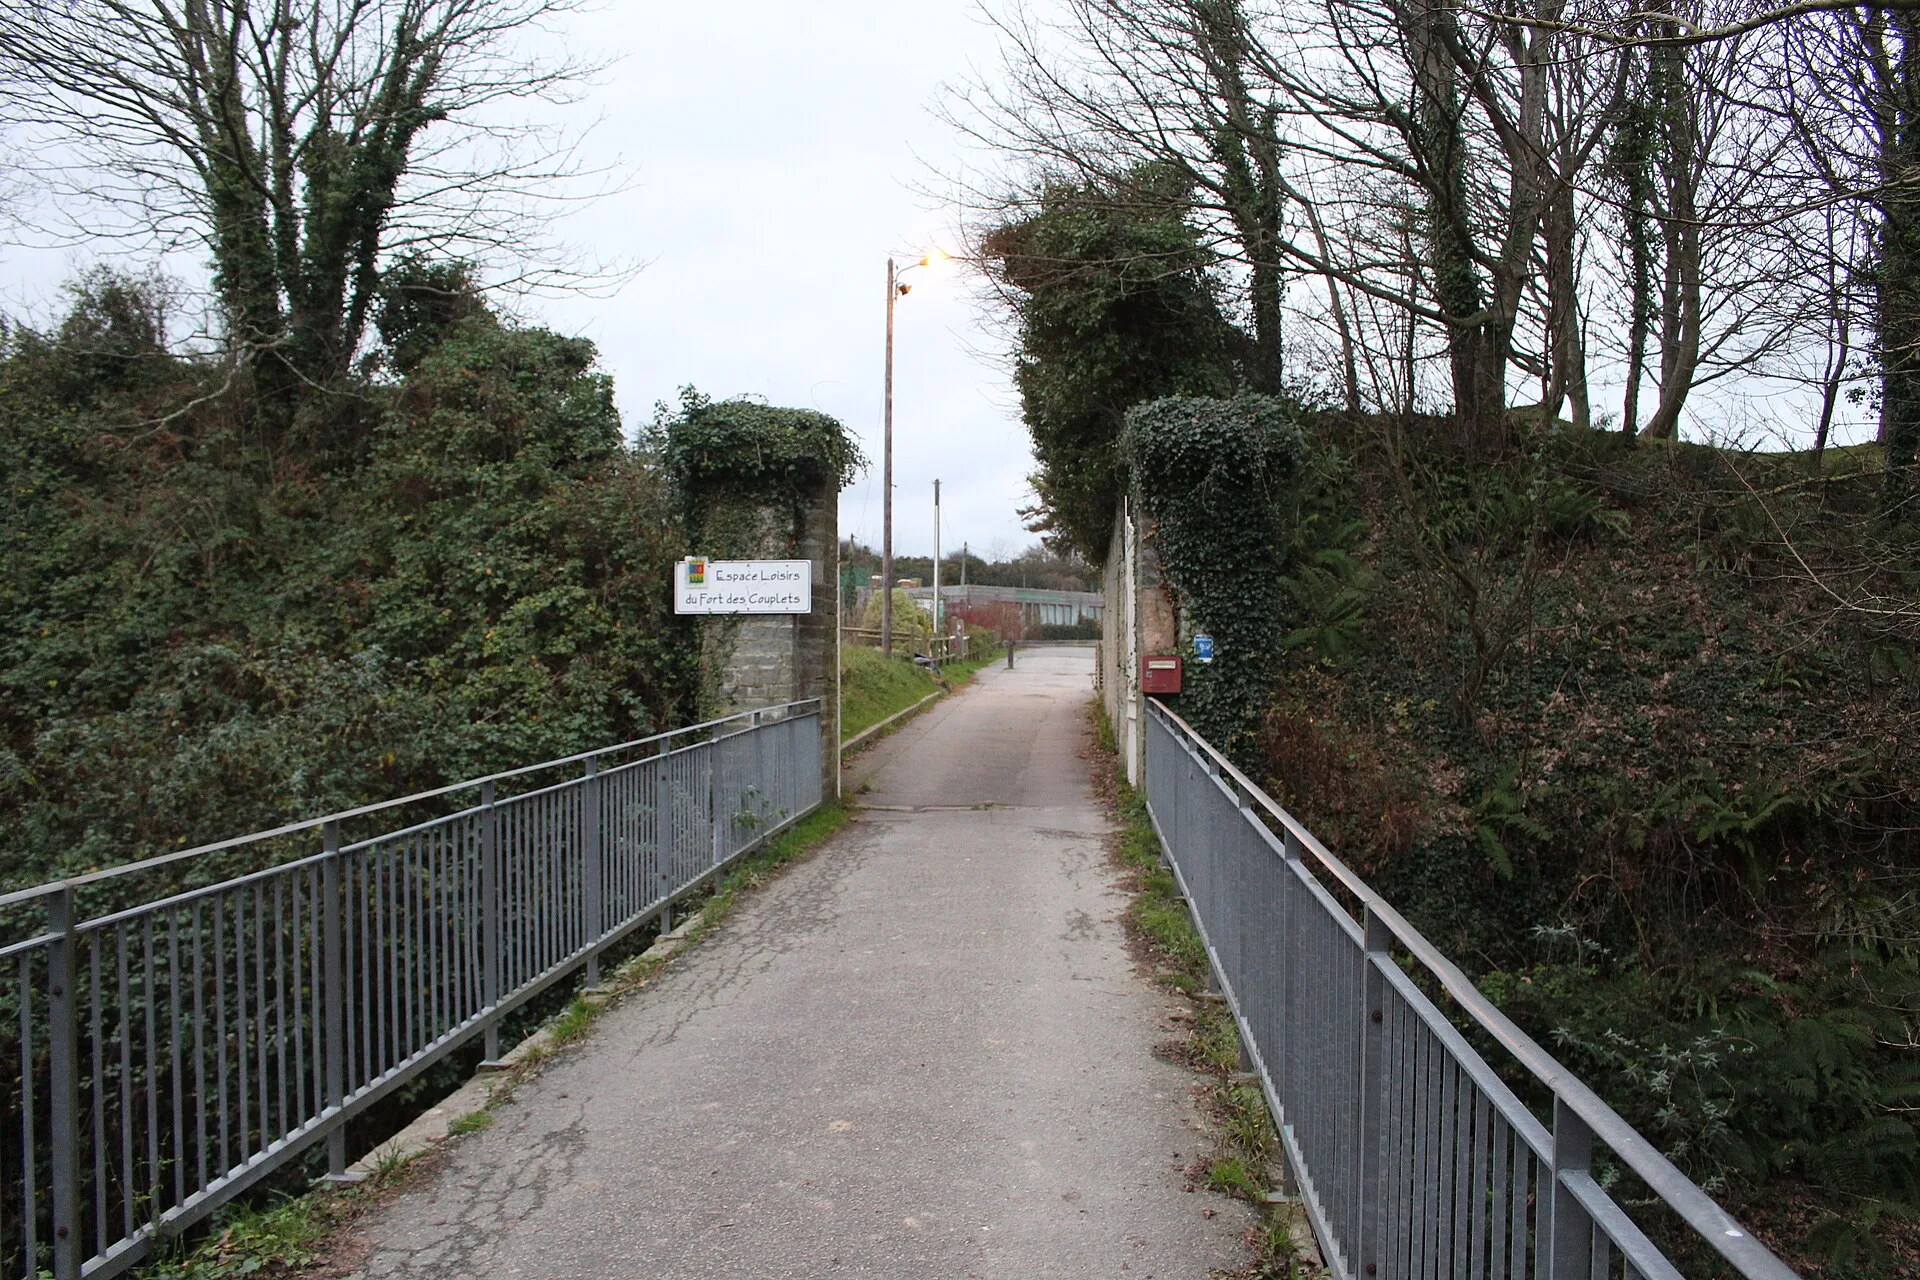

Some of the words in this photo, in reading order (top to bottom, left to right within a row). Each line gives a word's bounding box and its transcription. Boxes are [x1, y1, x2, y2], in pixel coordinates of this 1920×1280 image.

[716, 570, 757, 581] Espace
[760, 570, 800, 581] Loisirs
[685, 593, 697, 604] du
[699, 593, 724, 605] Fort
[726, 593, 746, 604] des
[748, 593, 800, 607] Couplets
